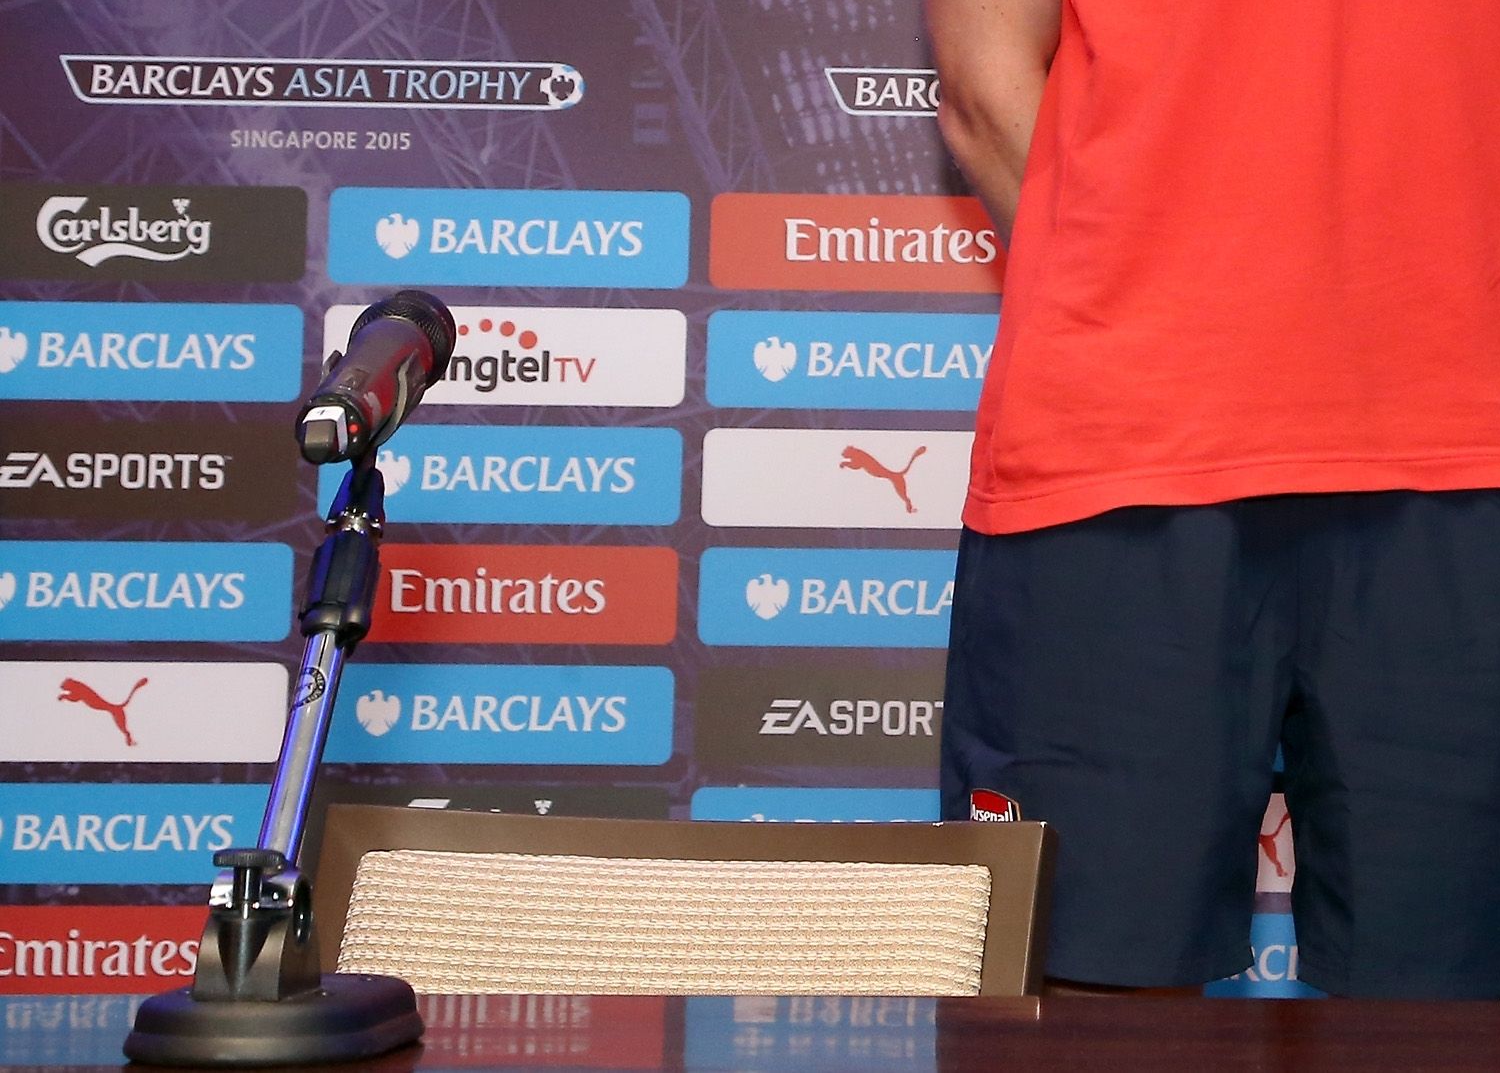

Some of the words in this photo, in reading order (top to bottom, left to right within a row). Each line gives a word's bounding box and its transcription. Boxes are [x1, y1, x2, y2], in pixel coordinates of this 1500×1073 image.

[88, 65, 274, 99] BARCLAYS
[283, 68, 371, 98] ASIA
[383, 70, 531, 100] TROPHY
[855, 77, 939, 108] BARC
[231, 130, 357, 149] SINGAPORE
[365, 132, 410, 150] 2015
[37, 197, 211, 266] Carlsberg
[430, 219, 642, 256] BARCLAYS
[785, 218, 995, 263] Emirates
[38, 333, 255, 370] BARCLAYS
[807, 342, 992, 379] BARCLAY
[443, 350, 551, 393] ngtel
[67, 453, 225, 489] SPORTS
[422, 456, 635, 493] BARCLAYS
[26, 572, 244, 609] BARCLAYS
[391, 568, 605, 613] Emirates
[800, 579, 954, 615] BARCLA
[412, 696, 626, 732] BARCLAYS
[759, 700, 827, 734] EA
[829, 700, 943, 736] SPOR
[14, 815, 233, 851] BARCLAYS
[0, 930, 198, 977] Emirates
